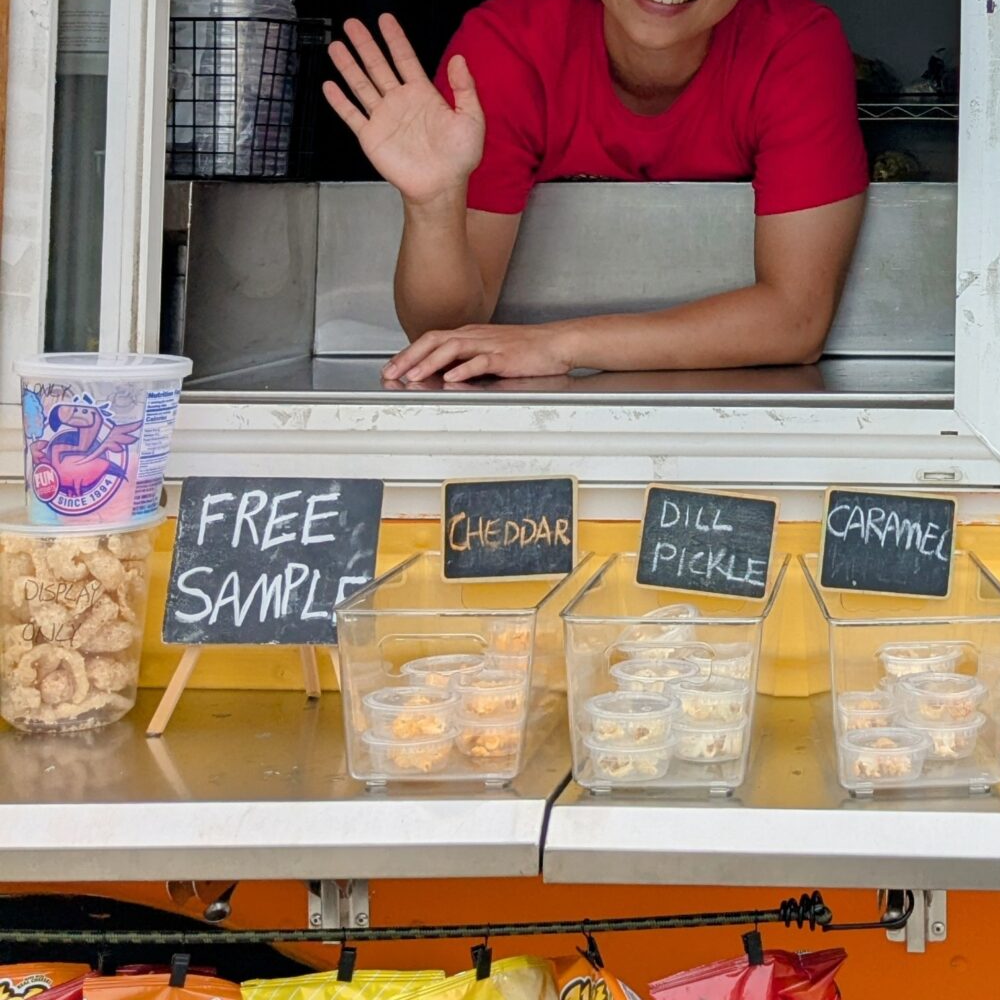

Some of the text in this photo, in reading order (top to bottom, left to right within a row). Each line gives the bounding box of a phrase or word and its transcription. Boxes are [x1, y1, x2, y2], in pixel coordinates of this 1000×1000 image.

[34, 470, 56, 489] FUN
[57, 496, 88, 508] SINCE
[660, 499, 733, 532] DILL
[197, 489, 342, 551] FREE
[448, 511, 571, 552] CHEDDAR
[827, 504, 949, 562] CARAMEL
[652, 540, 767, 587] PICKLE
[24, 579, 102, 605] DISPLAY
[22, 622, 82, 647] ONLY
